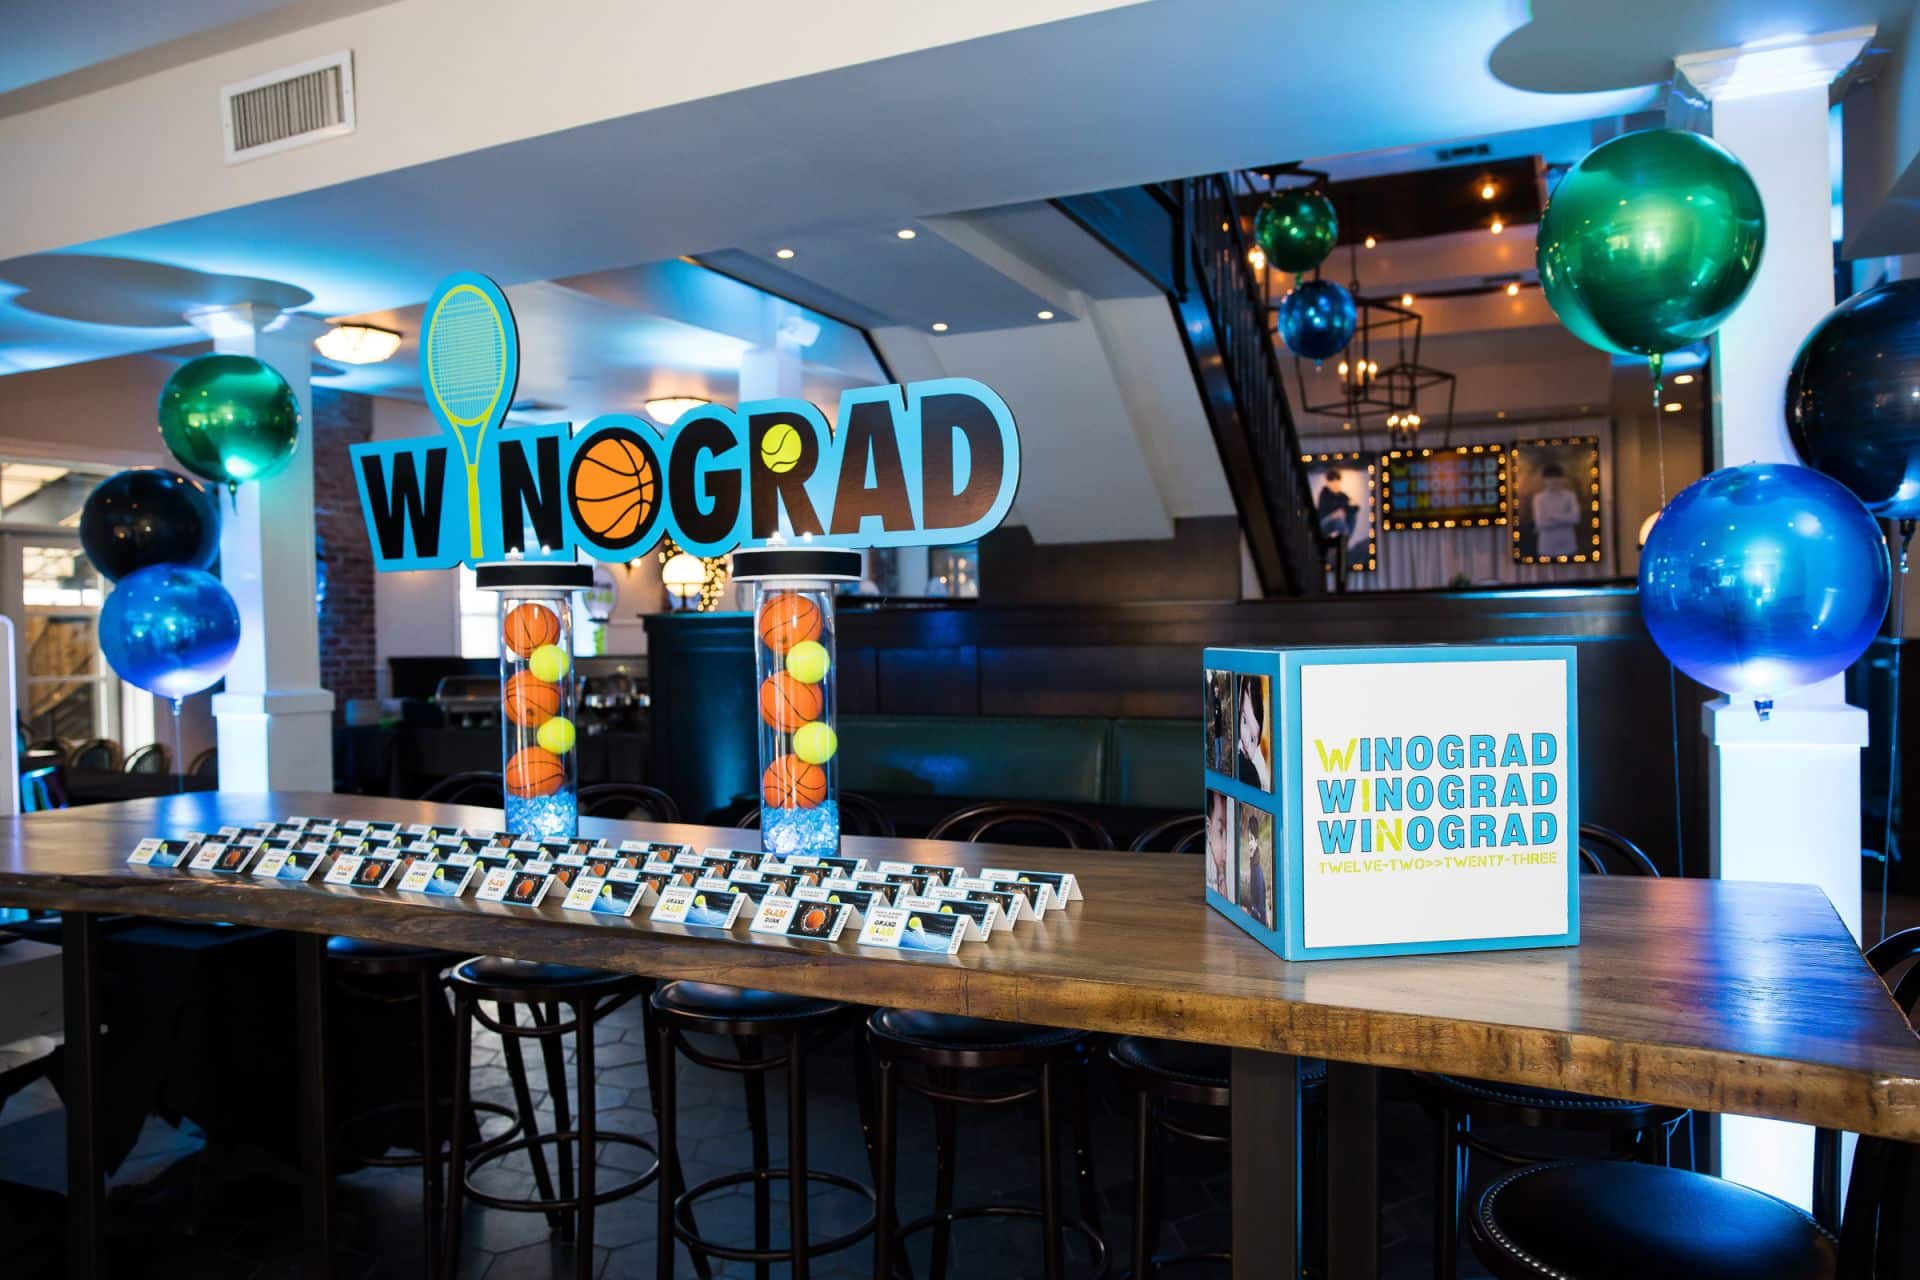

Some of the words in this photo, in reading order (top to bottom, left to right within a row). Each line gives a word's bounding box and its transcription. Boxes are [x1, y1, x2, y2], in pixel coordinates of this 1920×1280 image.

[360, 284, 1003, 558] WINOGRAD
[1314, 733, 1557, 772] WINOGRAD
[1317, 772, 1557, 813] WINOGRAD
[1317, 812, 1557, 854] WINOGRAD
